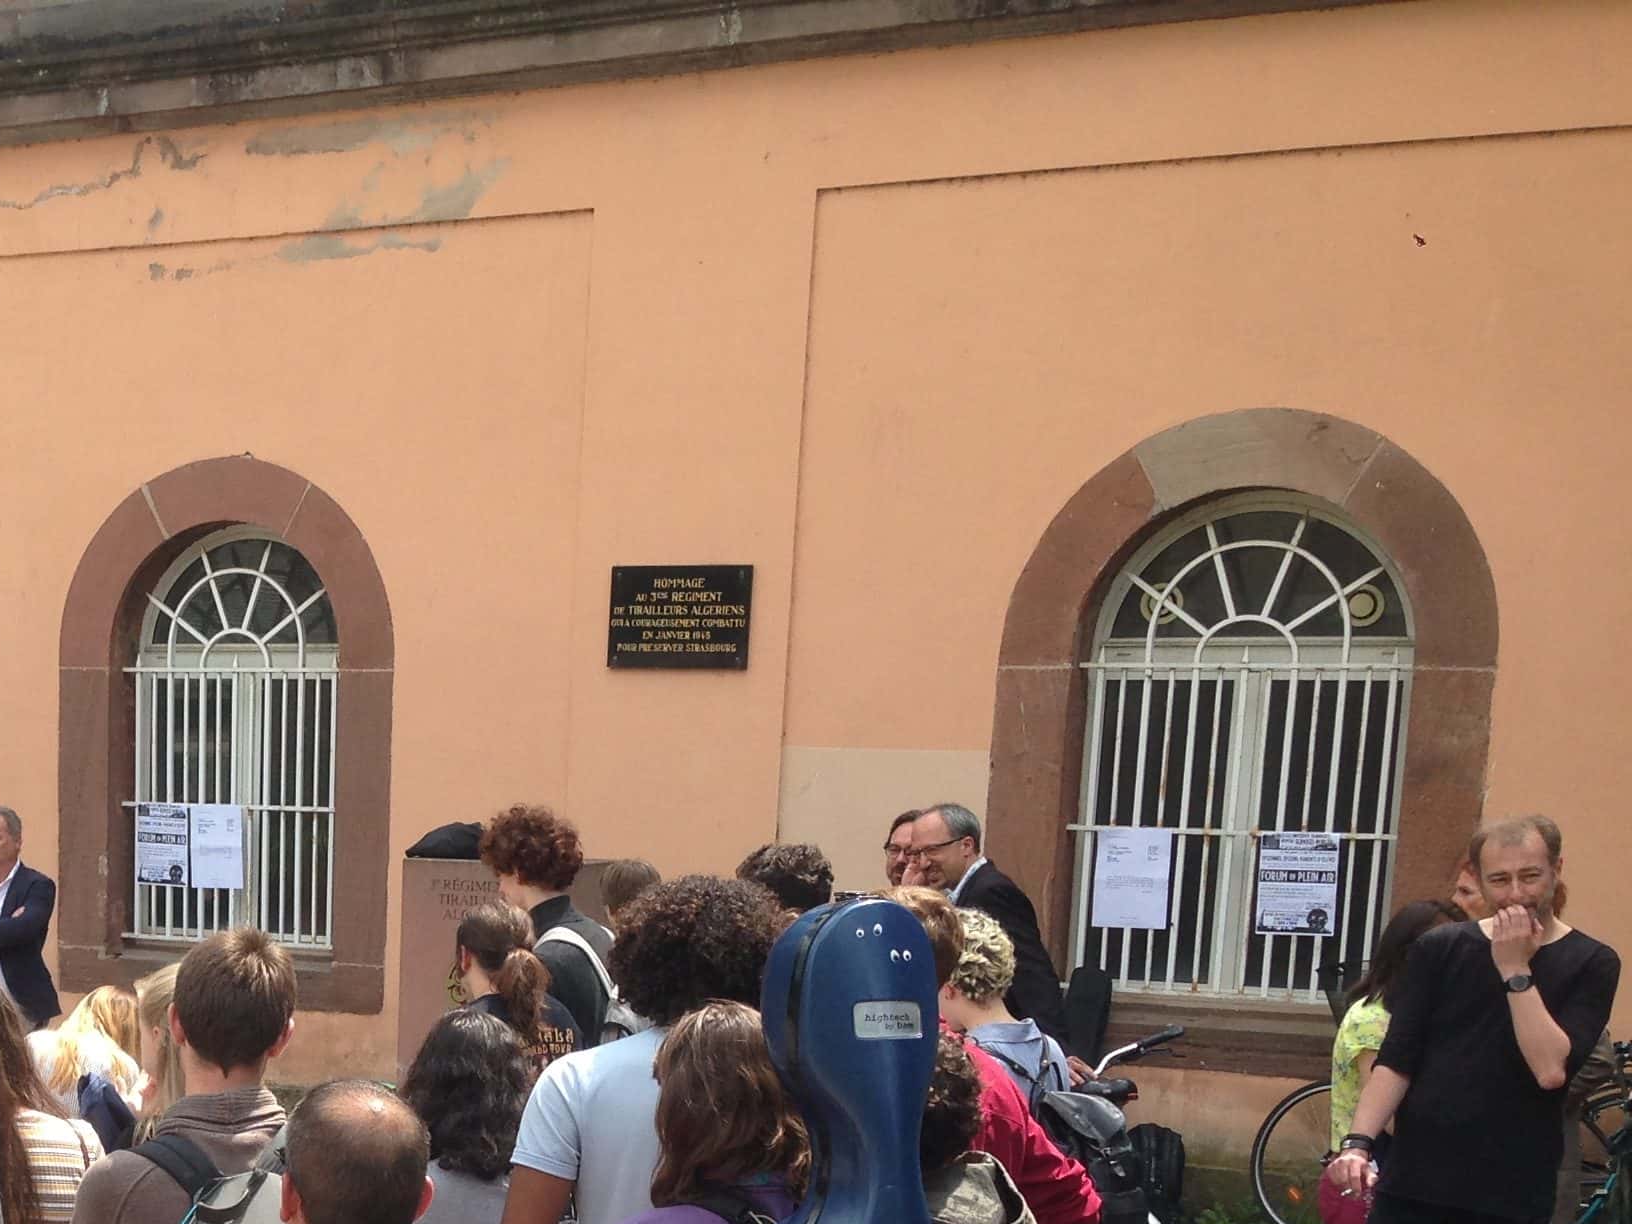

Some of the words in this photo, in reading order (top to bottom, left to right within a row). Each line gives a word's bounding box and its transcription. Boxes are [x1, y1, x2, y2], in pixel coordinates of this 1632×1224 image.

[653, 577, 706, 588] HOMMAGE
[635, 593, 648, 602] AU
[671, 591, 723, 602] REGIMENT
[613, 606, 625, 615] DE
[628, 605, 689, 616] TIRAILLEURS
[690, 605, 745, 616] ALGERIENS
[631, 618, 700, 628] COURAGEUSEMENT
[701, 618, 745, 628] COMBATTU
[642, 631, 654, 640] EN
[655, 631, 690, 640] JANVIER
[692, 631, 711, 640] 1945
[616, 643, 638, 653] POUR
[638, 643, 684, 653] PRESERVER
[685, 643, 737, 653] STRASBOURG
[1260, 871, 1288, 882] FORUM
[1297, 871, 1319, 882] PLEIN
[1320, 872, 1335, 883] AIR
[864, 1013, 910, 1023] hightech
